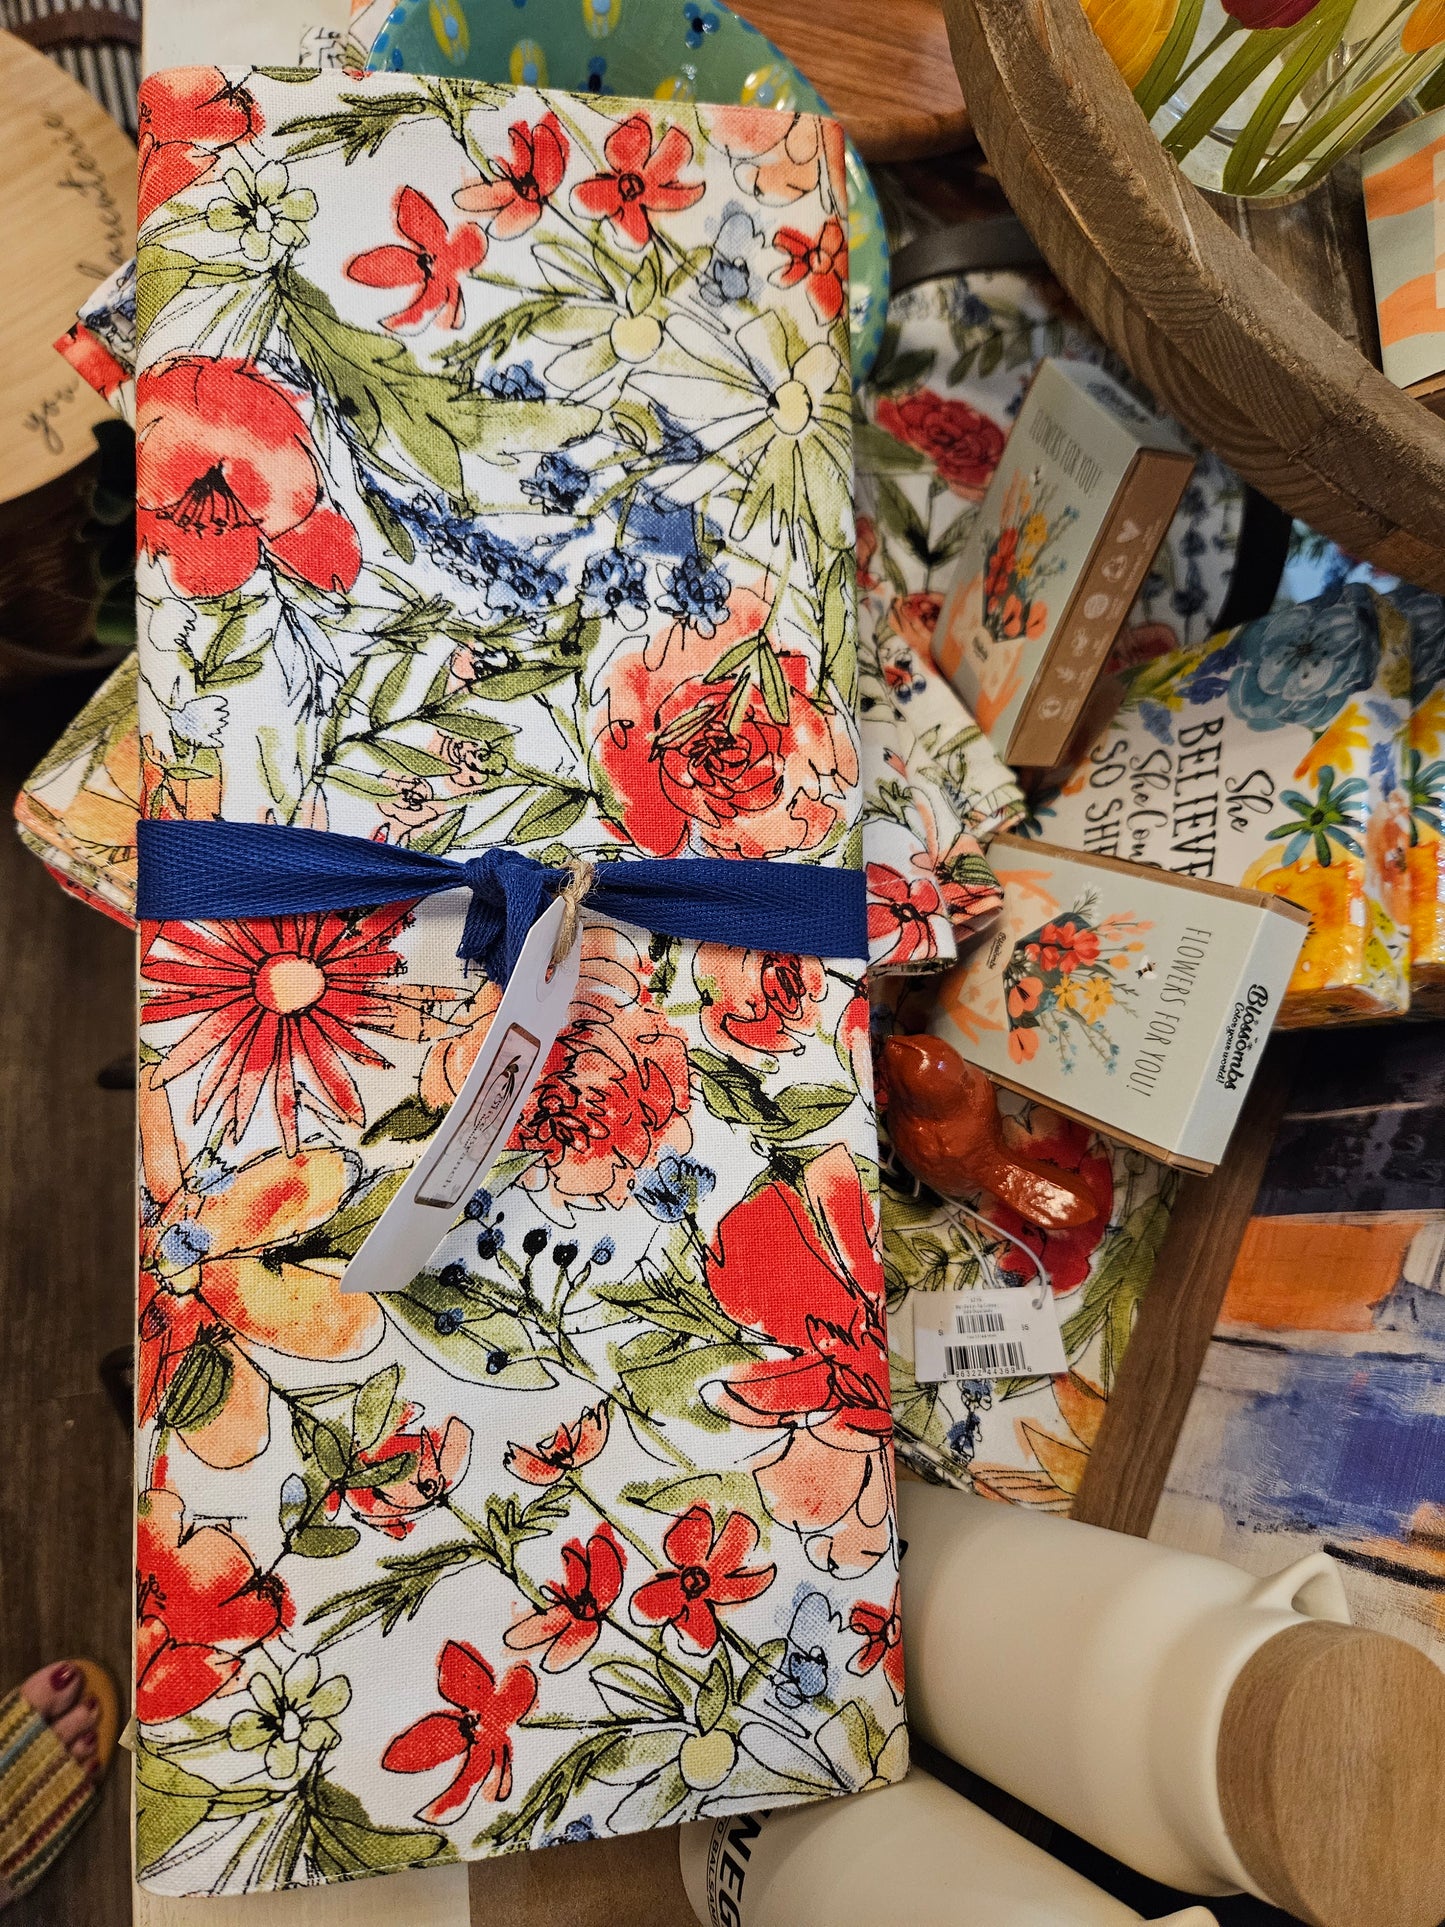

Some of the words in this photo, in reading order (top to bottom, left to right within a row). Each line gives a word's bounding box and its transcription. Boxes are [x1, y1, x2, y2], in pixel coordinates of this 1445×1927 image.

[1089, 740, 1128, 788] SO
[1129, 749, 1173, 807] She
[1225, 769, 1275, 833] She
[1160, 927, 1212, 1006] FLOWERS
[1144, 1011, 1180, 1045] FOR
[1224, 984, 1269, 1090] Blossombs
[1230, 1002, 1245, 1028] Color
[1126, 1050, 1166, 1097] YOU!
[719, 1809, 773, 1927] NEG
